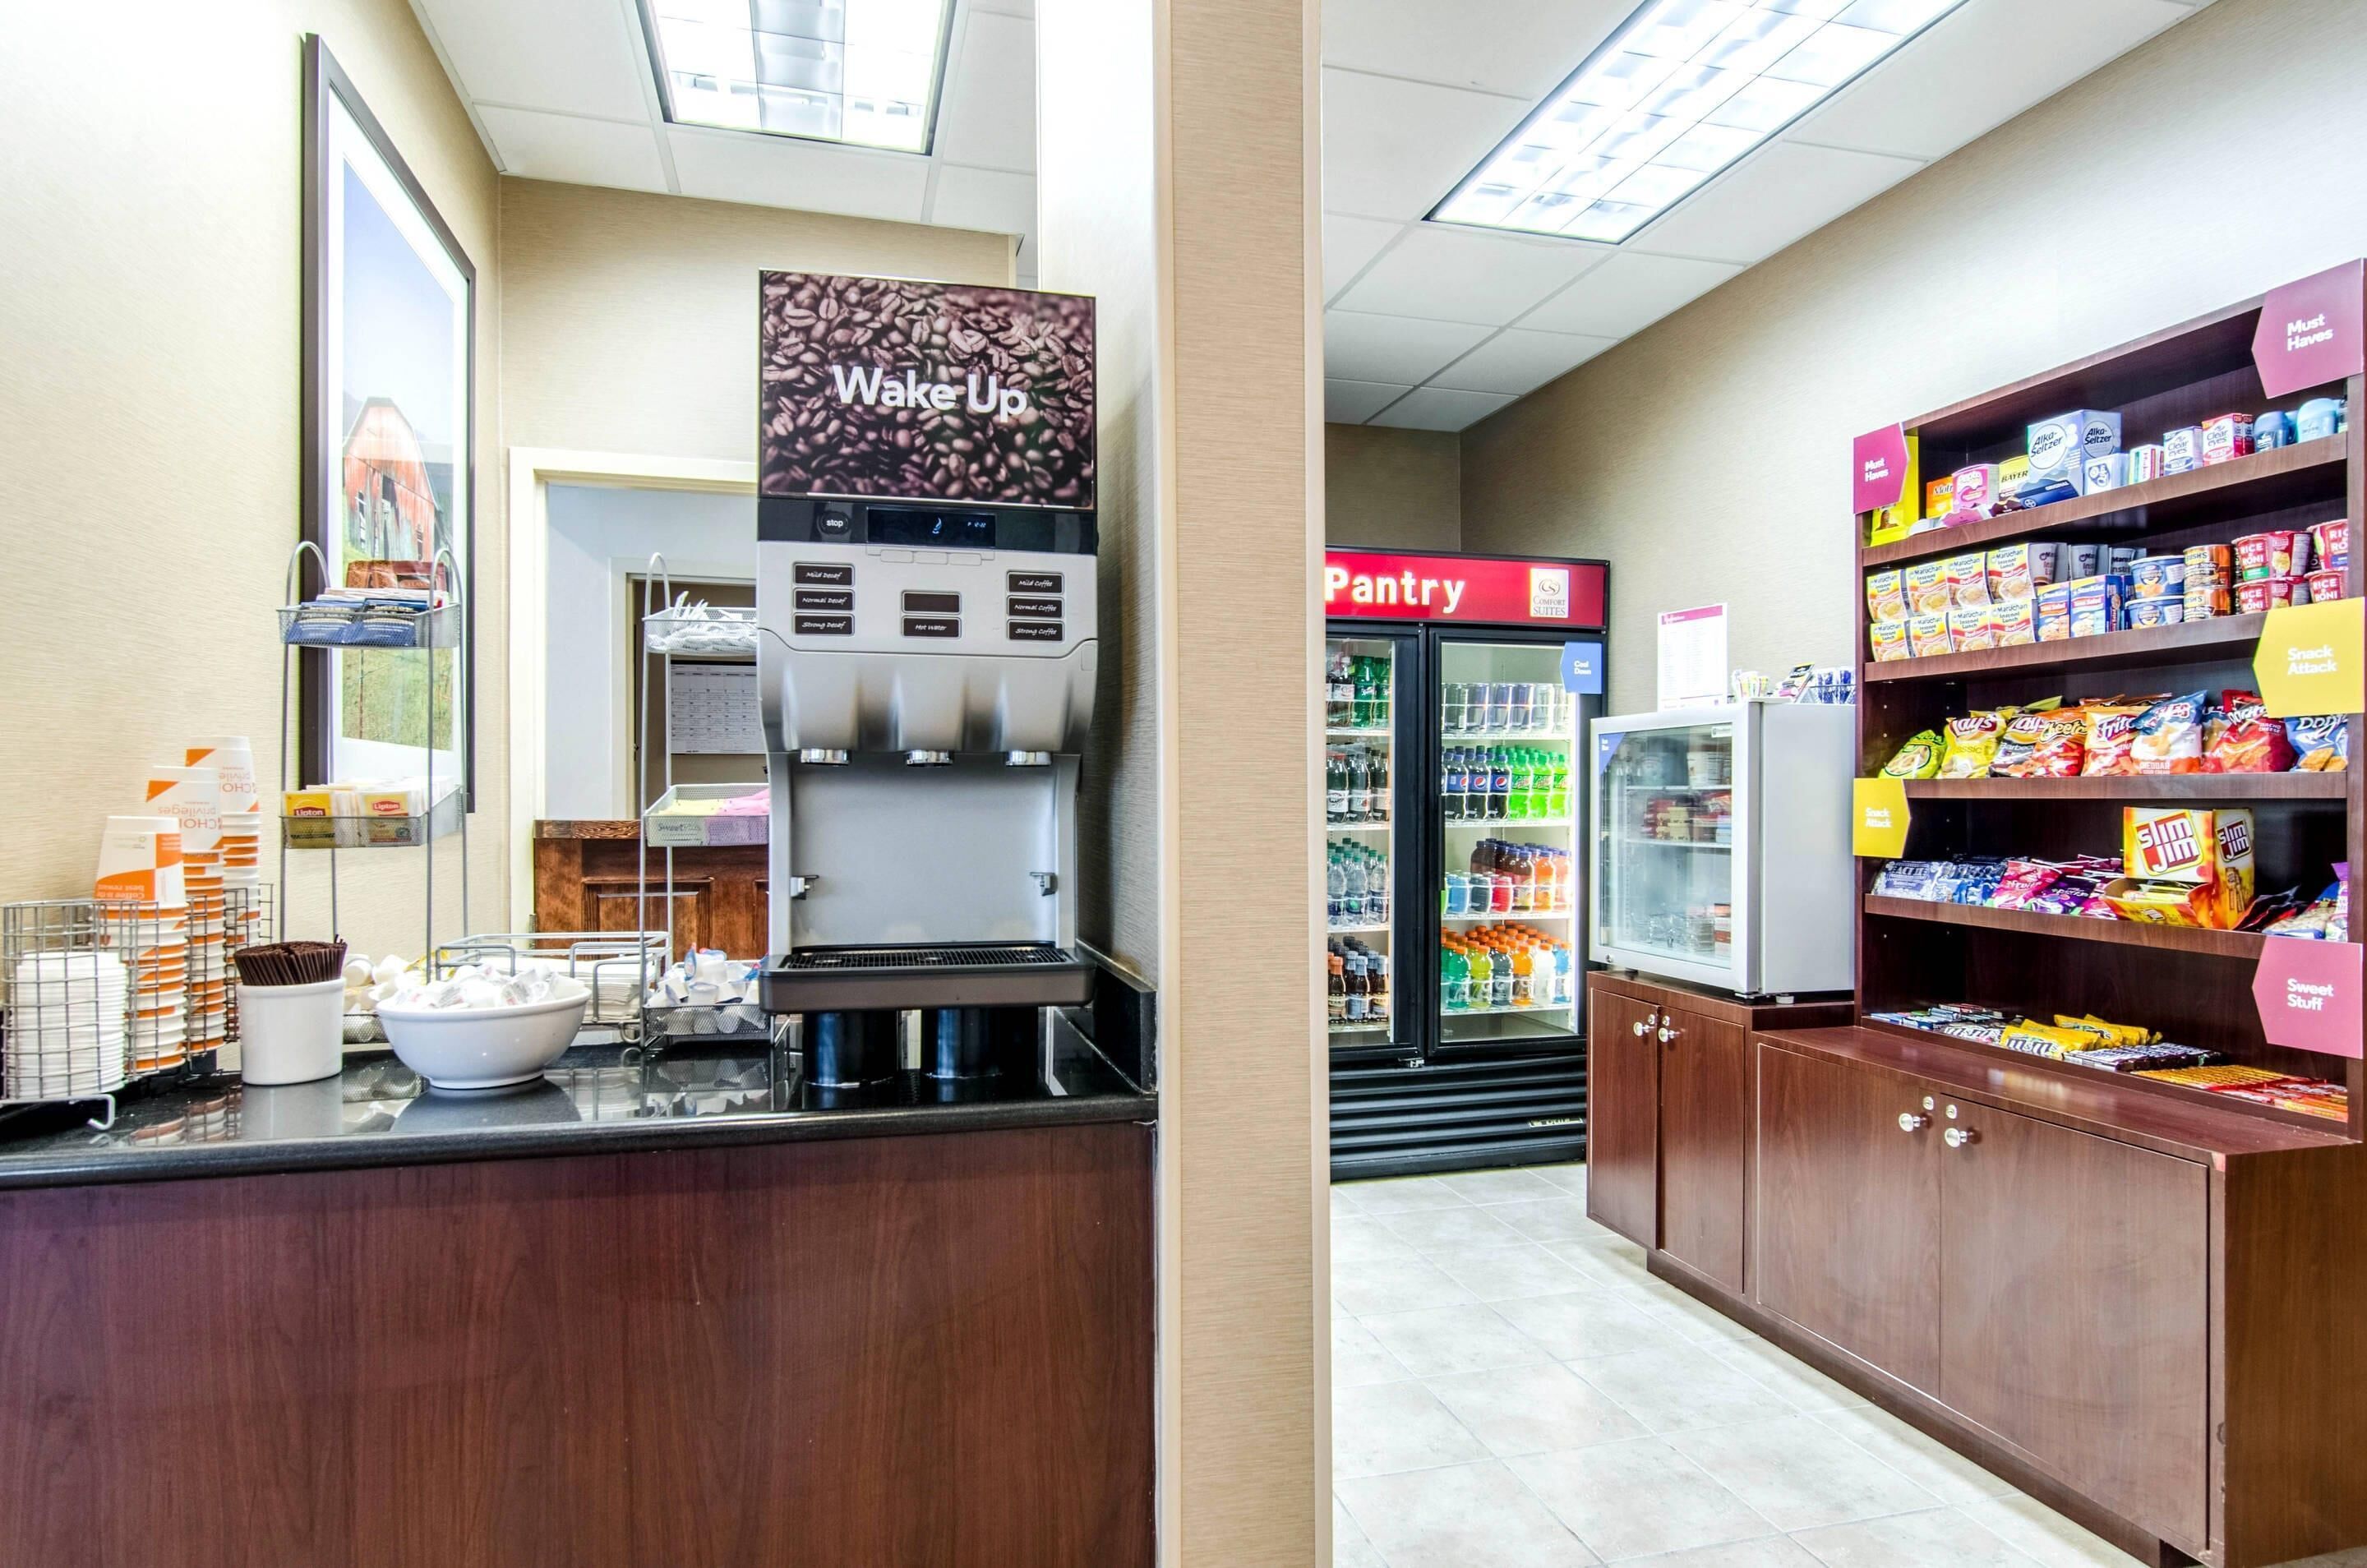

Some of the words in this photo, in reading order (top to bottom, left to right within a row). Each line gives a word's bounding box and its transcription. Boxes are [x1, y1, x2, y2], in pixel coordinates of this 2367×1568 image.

[2287, 313, 2325, 336] Must
[2287, 329, 2334, 351] Haves
[833, 365, 957, 411] Wake
[968, 373, 1028, 423] Up
[2088, 427, 2107, 437] Alka-
[2206, 429, 2229, 441] Clear
[2083, 436, 2112, 445] Seltzer
[2167, 440, 2189, 451] Clear
[2208, 436, 2227, 447] eyes
[2031, 436, 2063, 458] Seltzer
[2168, 448, 2188, 458] eyes
[2000, 470, 2028, 483] BAYER
[826, 519, 843, 528] stop
[2239, 542, 2263, 553] RICE
[2241, 555, 2264, 566] RONI
[823, 572, 842, 580] Decaf
[1034, 579, 1053, 588] Coffee
[2313, 578, 2337, 589] RICE
[1324, 566, 1465, 614] Pantry
[2240, 589, 2263, 600] RICE
[827, 597, 847, 605] Decaf
[1533, 597, 1566, 606] COMFORT
[2315, 591, 2338, 602] RONI
[1038, 604, 1057, 612] Coffee
[1533, 606, 1566, 616] SUITES
[2242, 602, 2263, 612] RONI
[801, 621, 826, 630] Strong
[826, 621, 847, 630] Decaf
[1038, 627, 1057, 636] Coffee
[2287, 644, 2333, 662] Snack
[2287, 659, 2337, 676] Attack
[2287, 978, 2334, 997] Sweet
[2287, 994, 2323, 1011] Stuff
